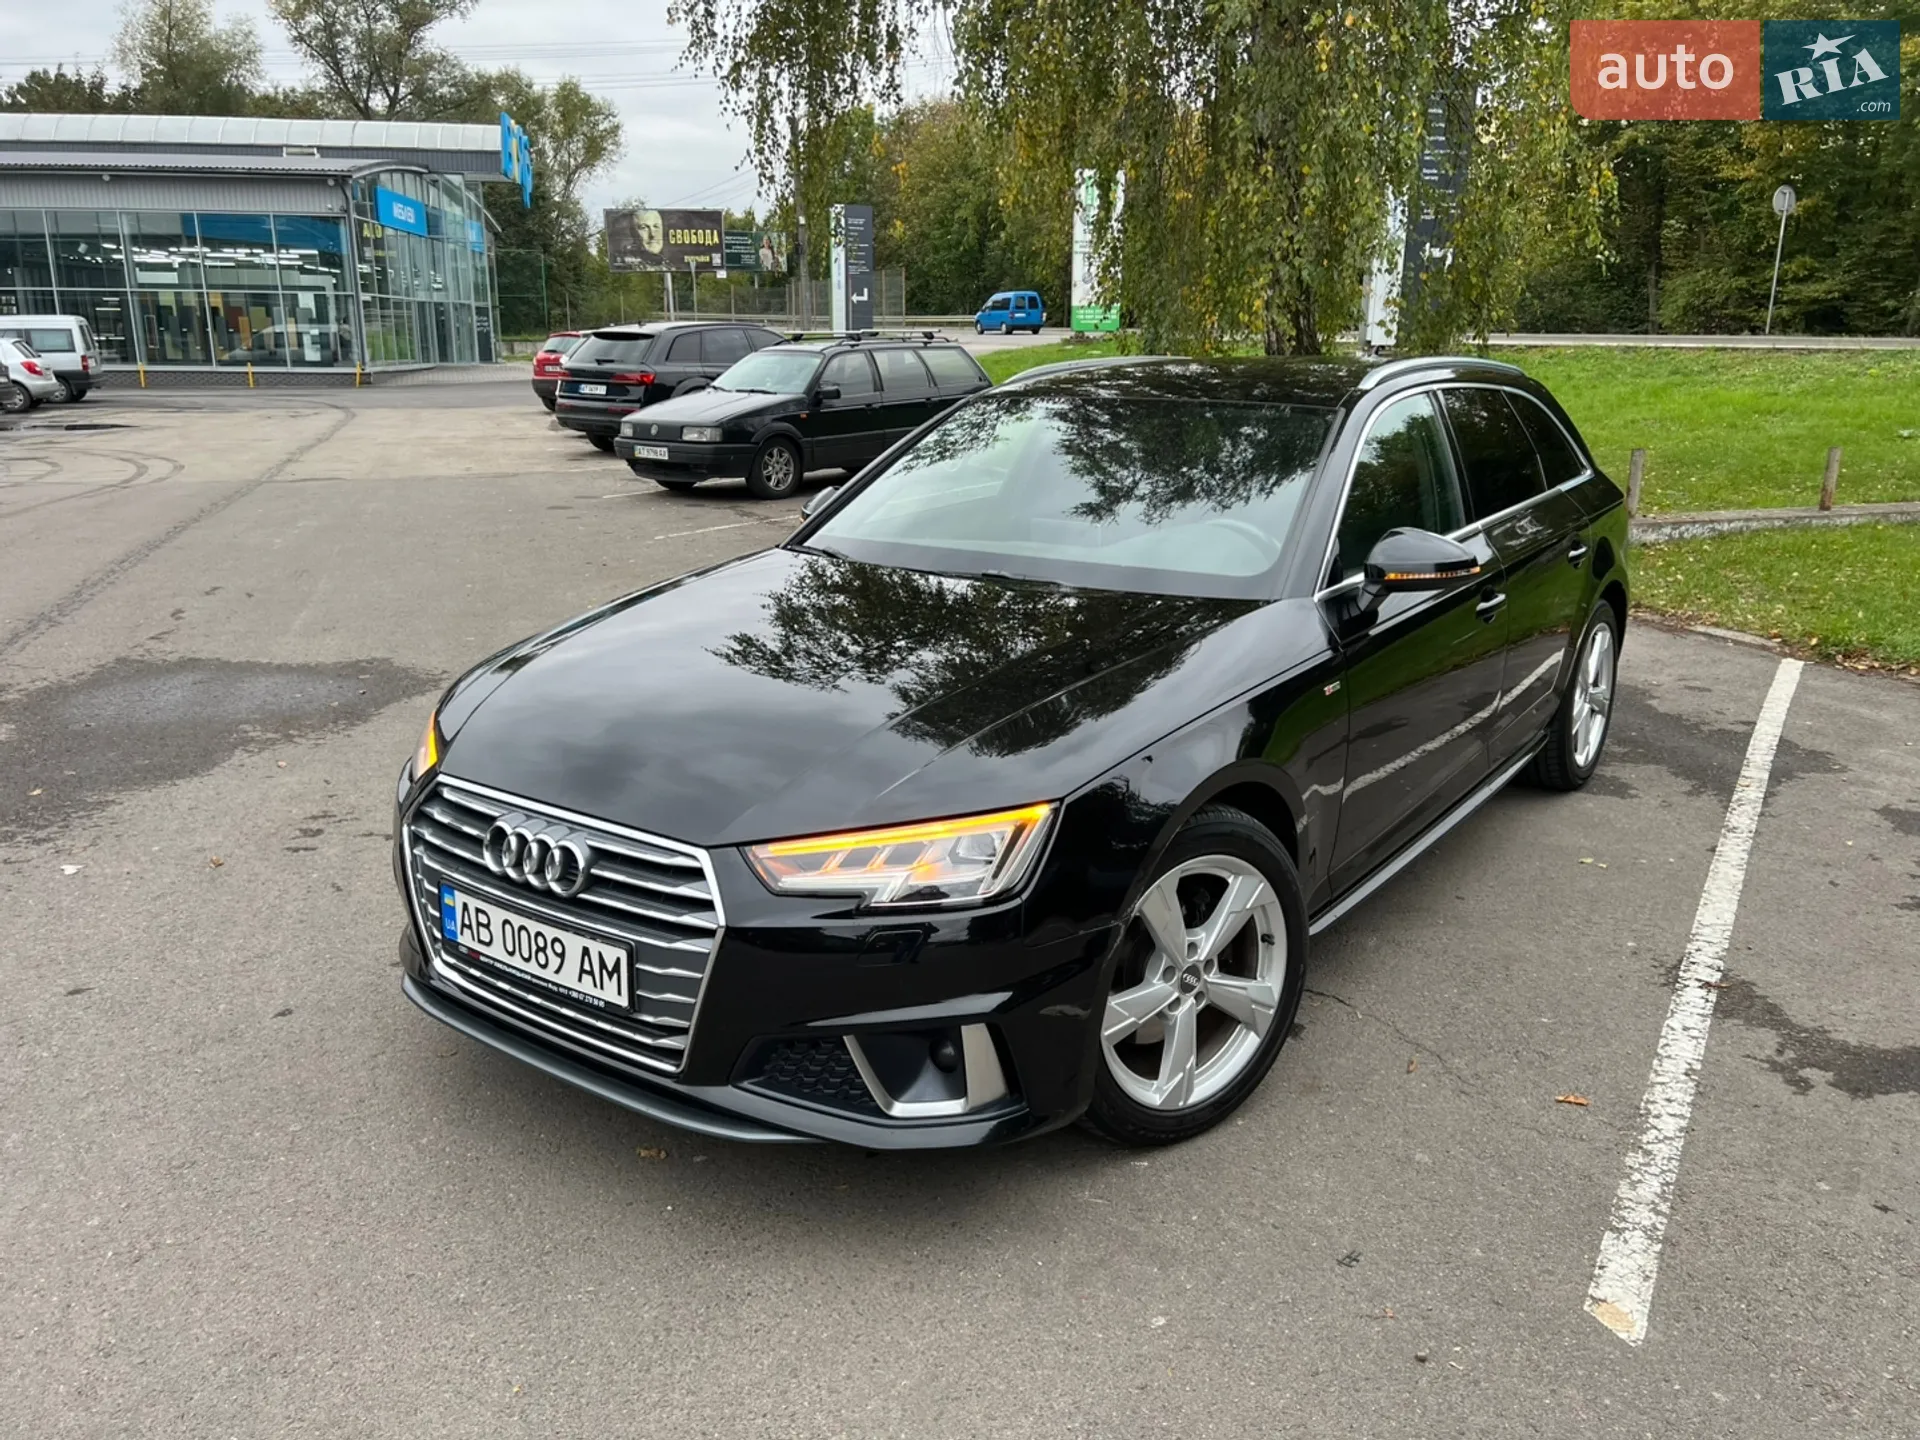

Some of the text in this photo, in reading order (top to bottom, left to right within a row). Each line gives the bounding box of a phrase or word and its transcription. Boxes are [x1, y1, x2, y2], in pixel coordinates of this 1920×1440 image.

[669, 229, 719, 246] СВОБОДА
[445, 918, 456, 931] UA
[460, 902, 622, 997] AB 0089 AM
